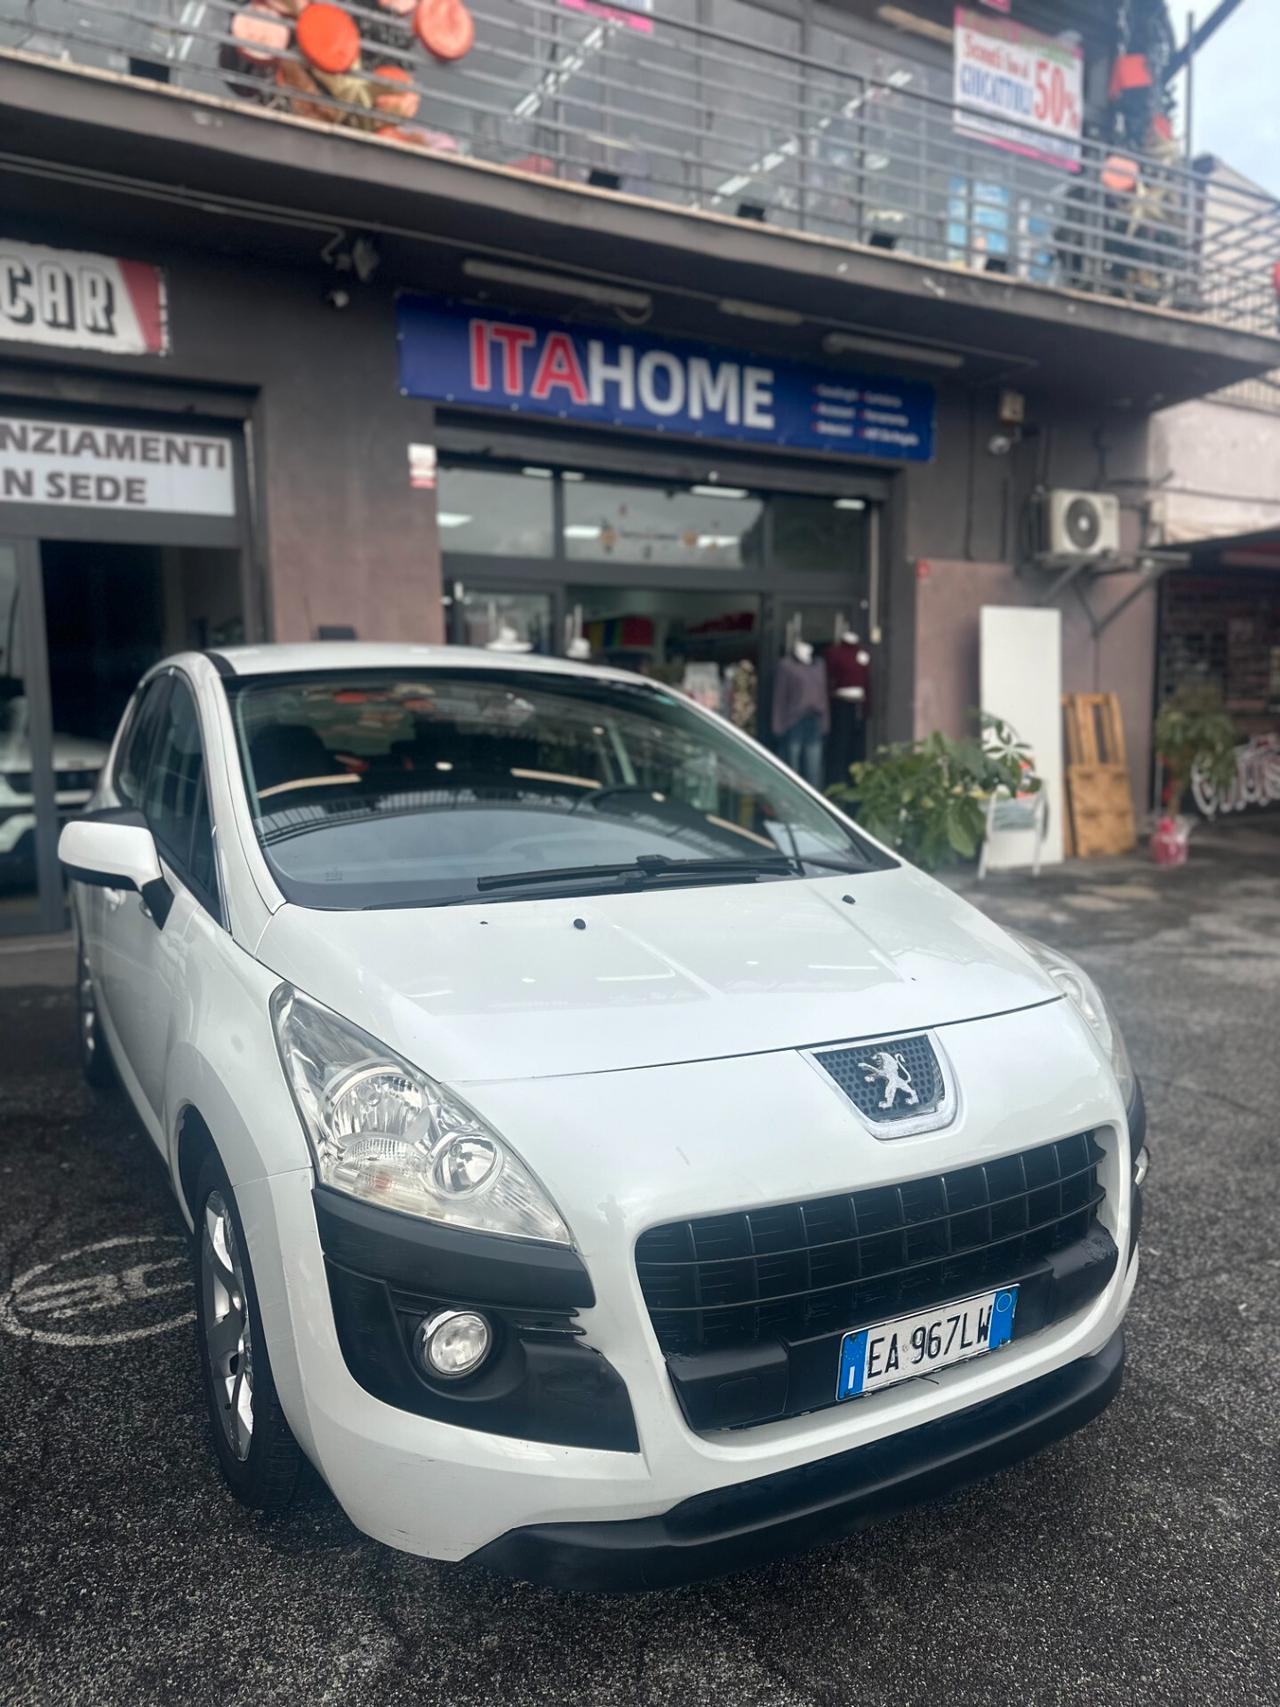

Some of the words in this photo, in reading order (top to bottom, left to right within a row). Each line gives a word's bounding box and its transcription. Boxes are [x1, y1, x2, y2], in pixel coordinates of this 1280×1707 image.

[0, 254, 116, 337] CAR
[469, 319, 775, 430] ITAHOME
[0, 423, 226, 469] NZIAMENTI
[46, 471, 147, 504] SEDE
[867, 1333, 900, 1379] EA
